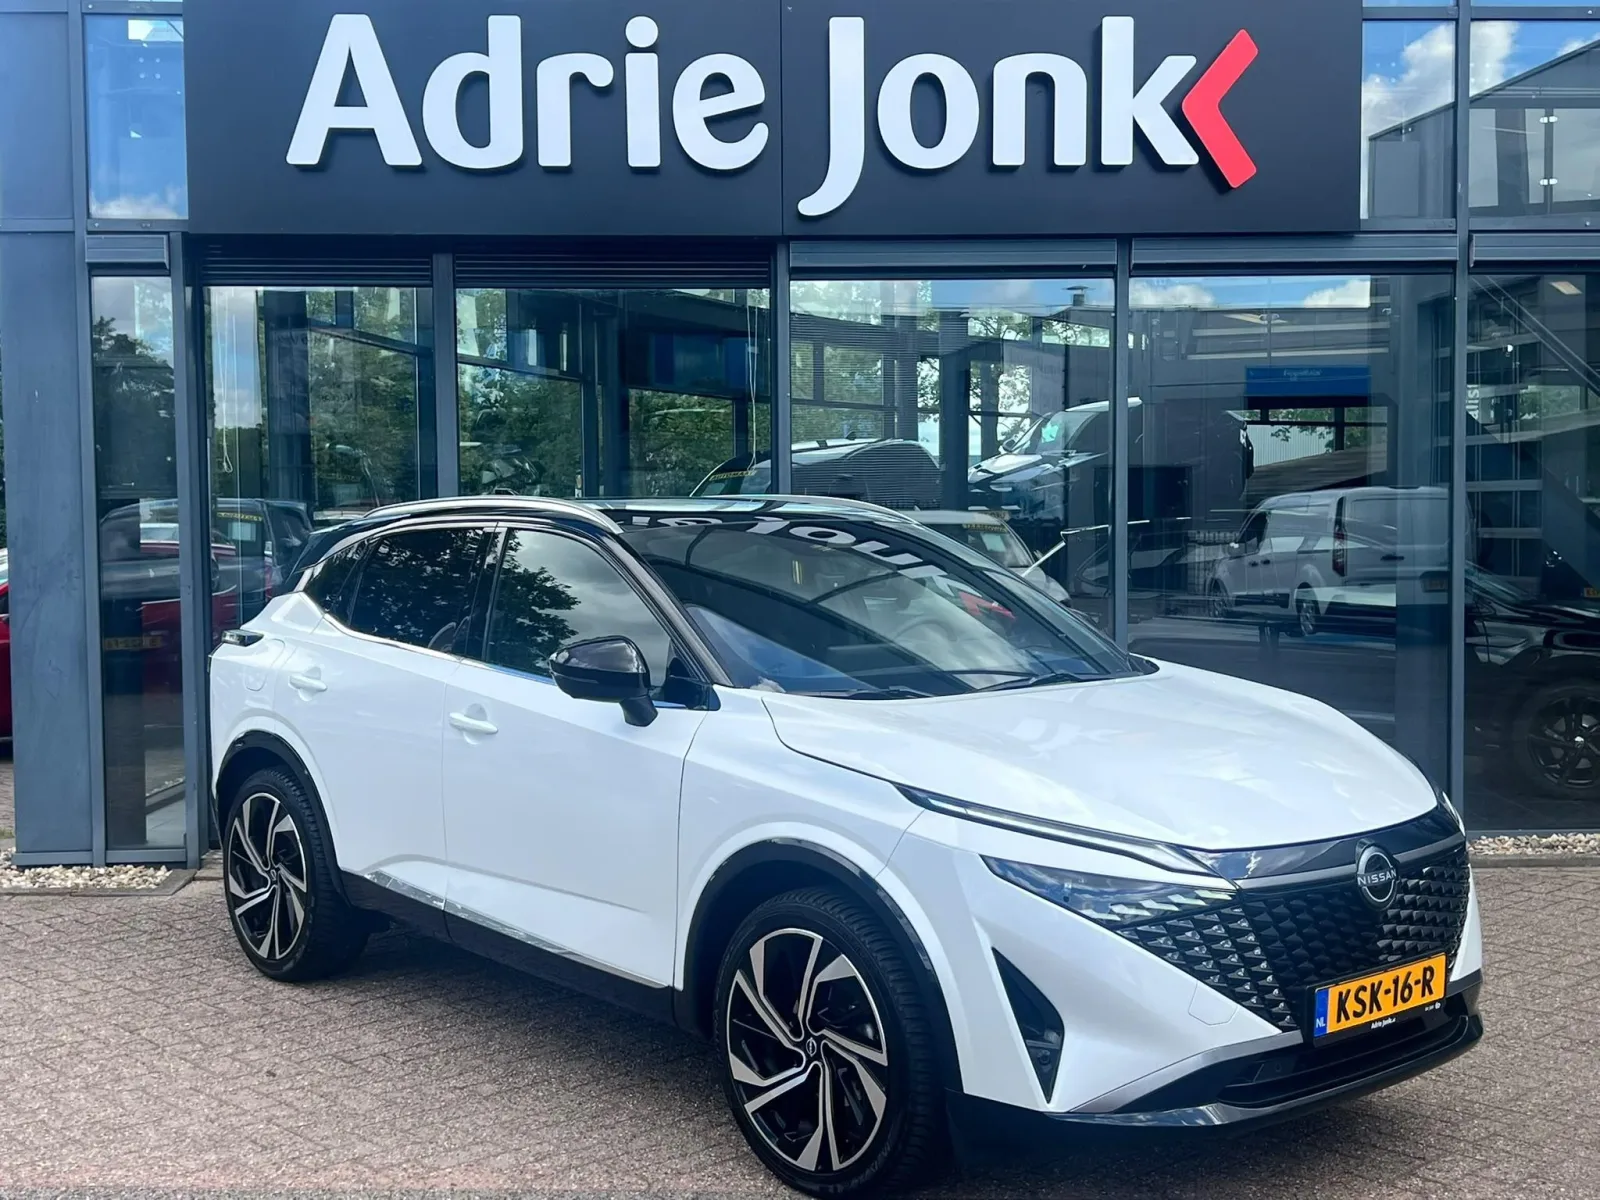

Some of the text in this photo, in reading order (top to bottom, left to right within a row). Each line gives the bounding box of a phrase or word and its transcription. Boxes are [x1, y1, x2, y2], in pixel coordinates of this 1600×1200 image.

[286, 13, 1199, 216] Adrie Jonk
[1357, 868, 1397, 886] NISSAN
[1335, 964, 1435, 1024] KSK-16-R
[1315, 1016, 1326, 1028] NL
